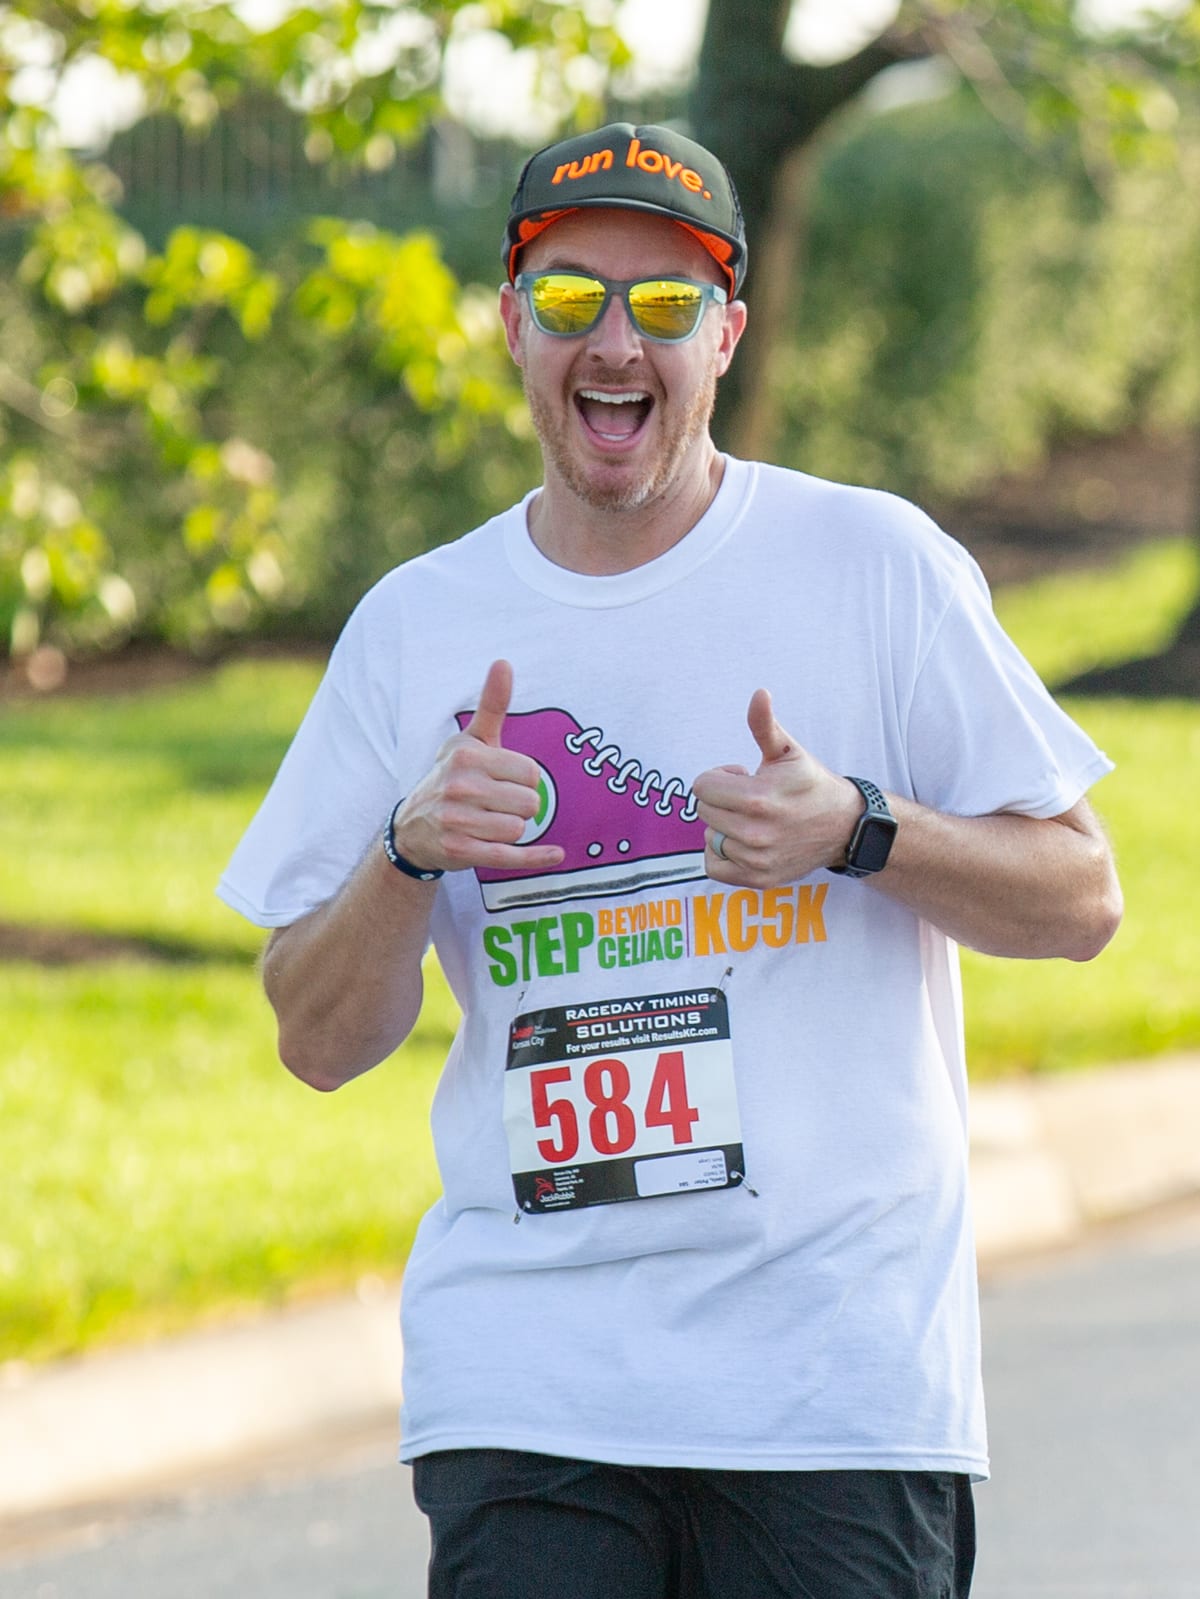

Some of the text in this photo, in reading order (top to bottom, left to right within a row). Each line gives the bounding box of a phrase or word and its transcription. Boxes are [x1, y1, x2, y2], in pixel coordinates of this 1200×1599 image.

[551, 138, 713, 200] run love.
[597, 898, 682, 937] BEYOND
[692, 882, 830, 957] KC5K
[483, 911, 594, 987] STEP
[597, 926, 683, 970] CELIAC
[565, 992, 710, 1021] RACEDAY TIMING
[576, 1011, 702, 1039] SOLUTIONS
[566, 1026, 718, 1055] For your results visit ResultsKC.com
[530, 1050, 699, 1163] 584
